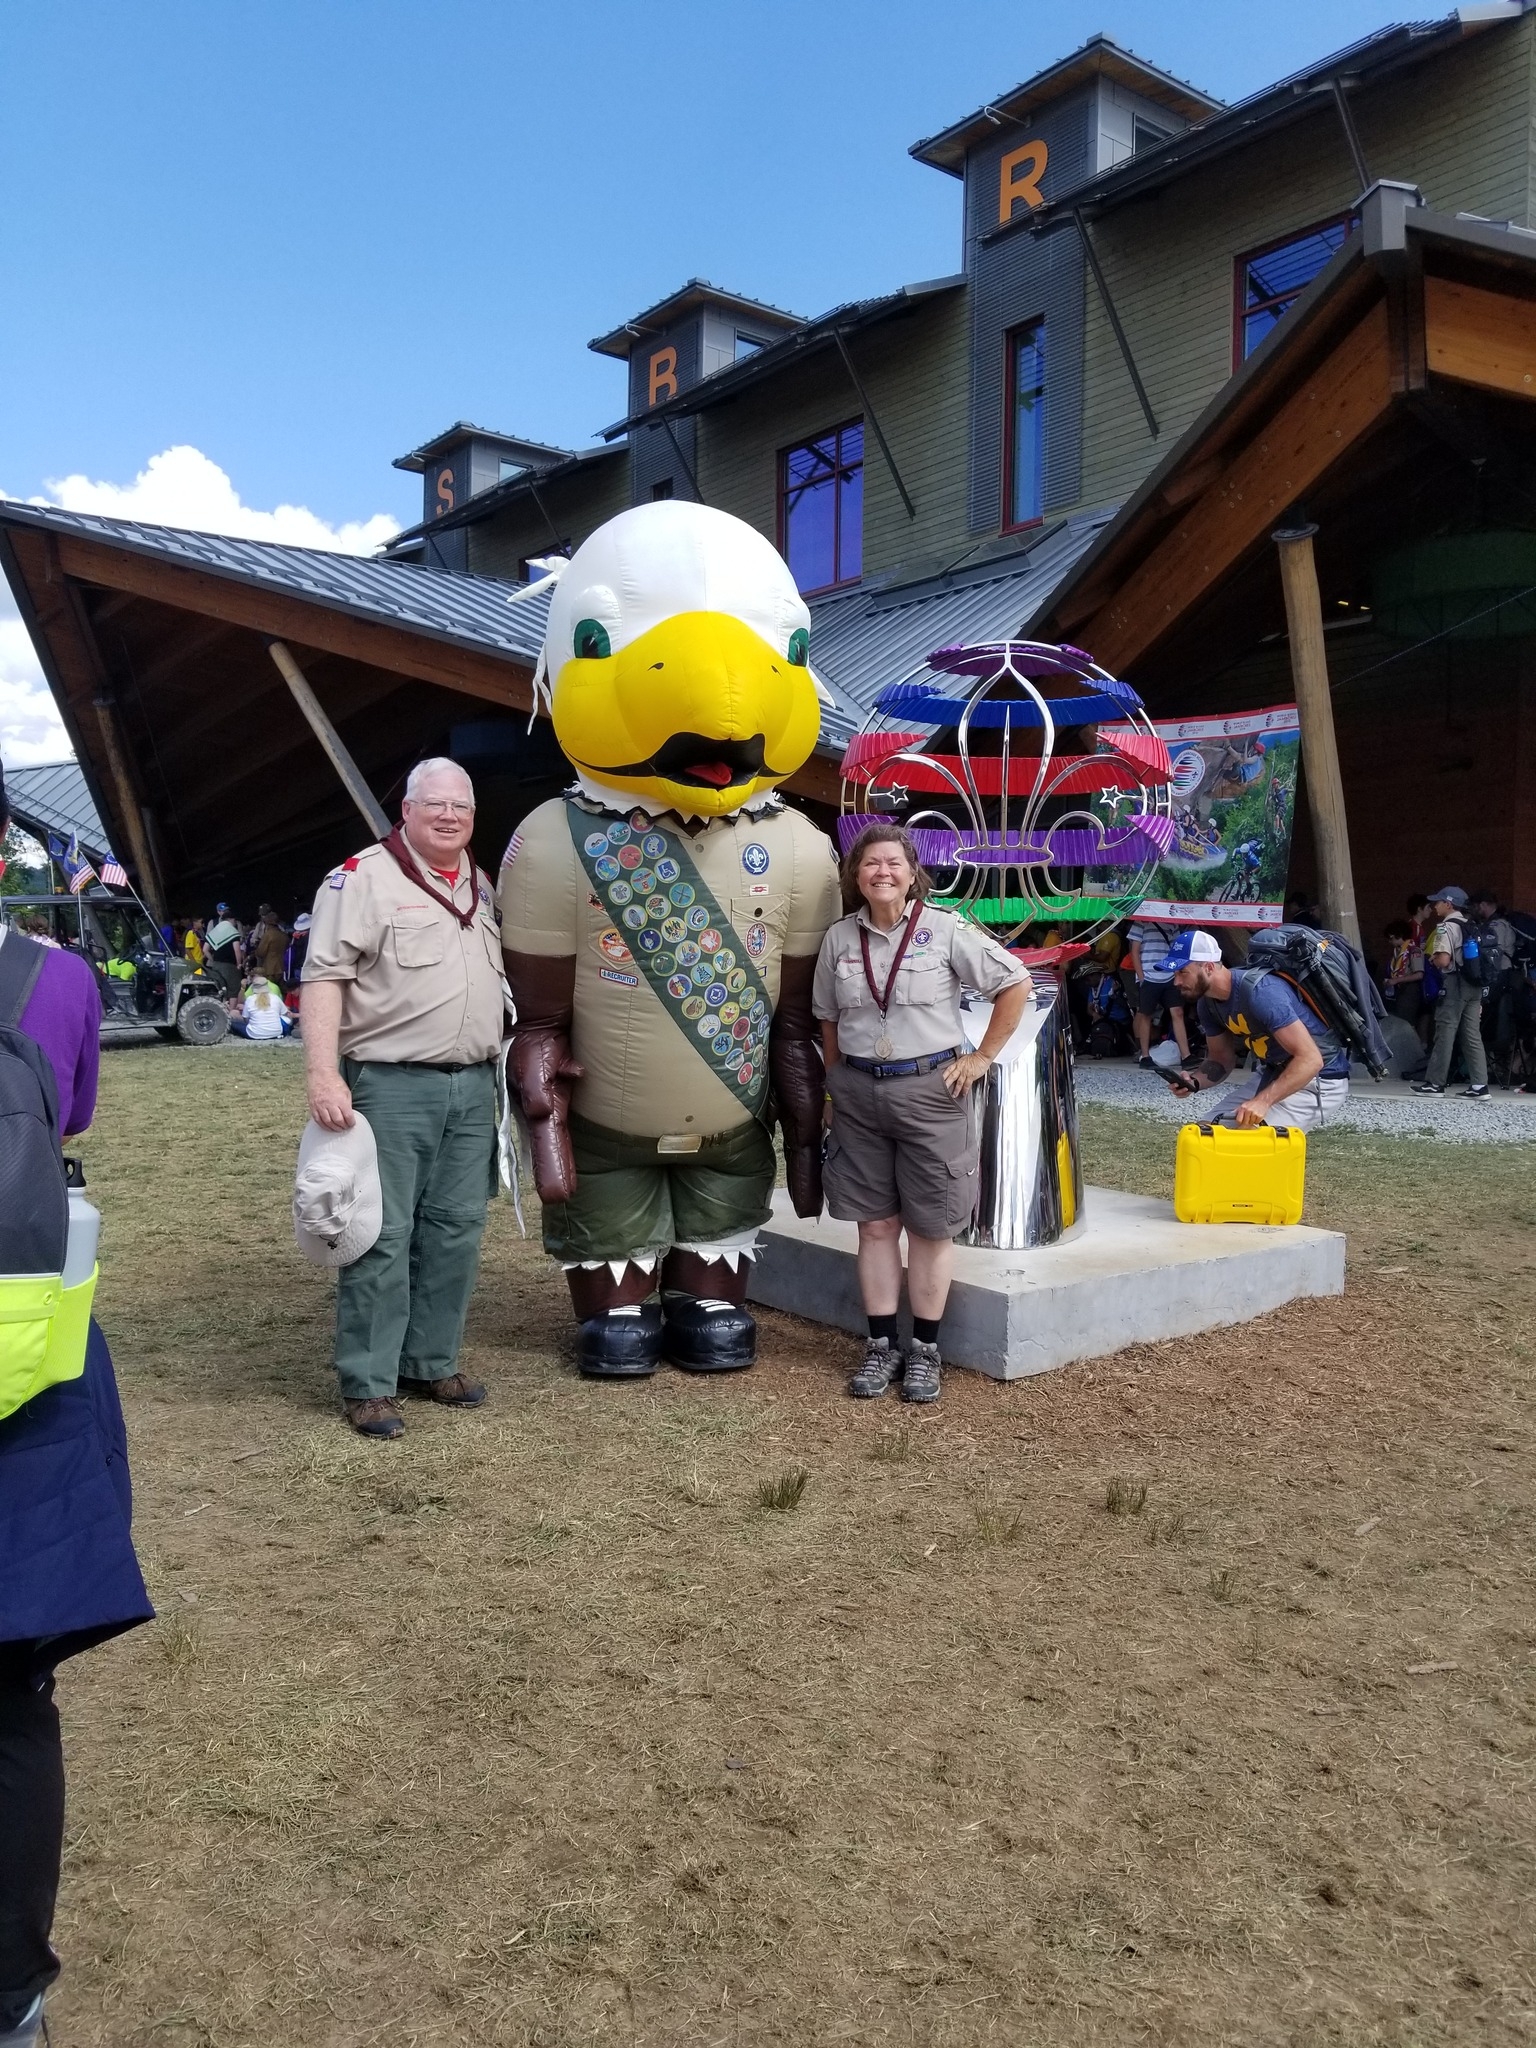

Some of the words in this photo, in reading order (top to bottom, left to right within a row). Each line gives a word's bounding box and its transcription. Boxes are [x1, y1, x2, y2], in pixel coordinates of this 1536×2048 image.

[999, 139, 1048, 224] R
[436, 469, 454, 516] S
[606, 971, 636, 984] RECRUITER
